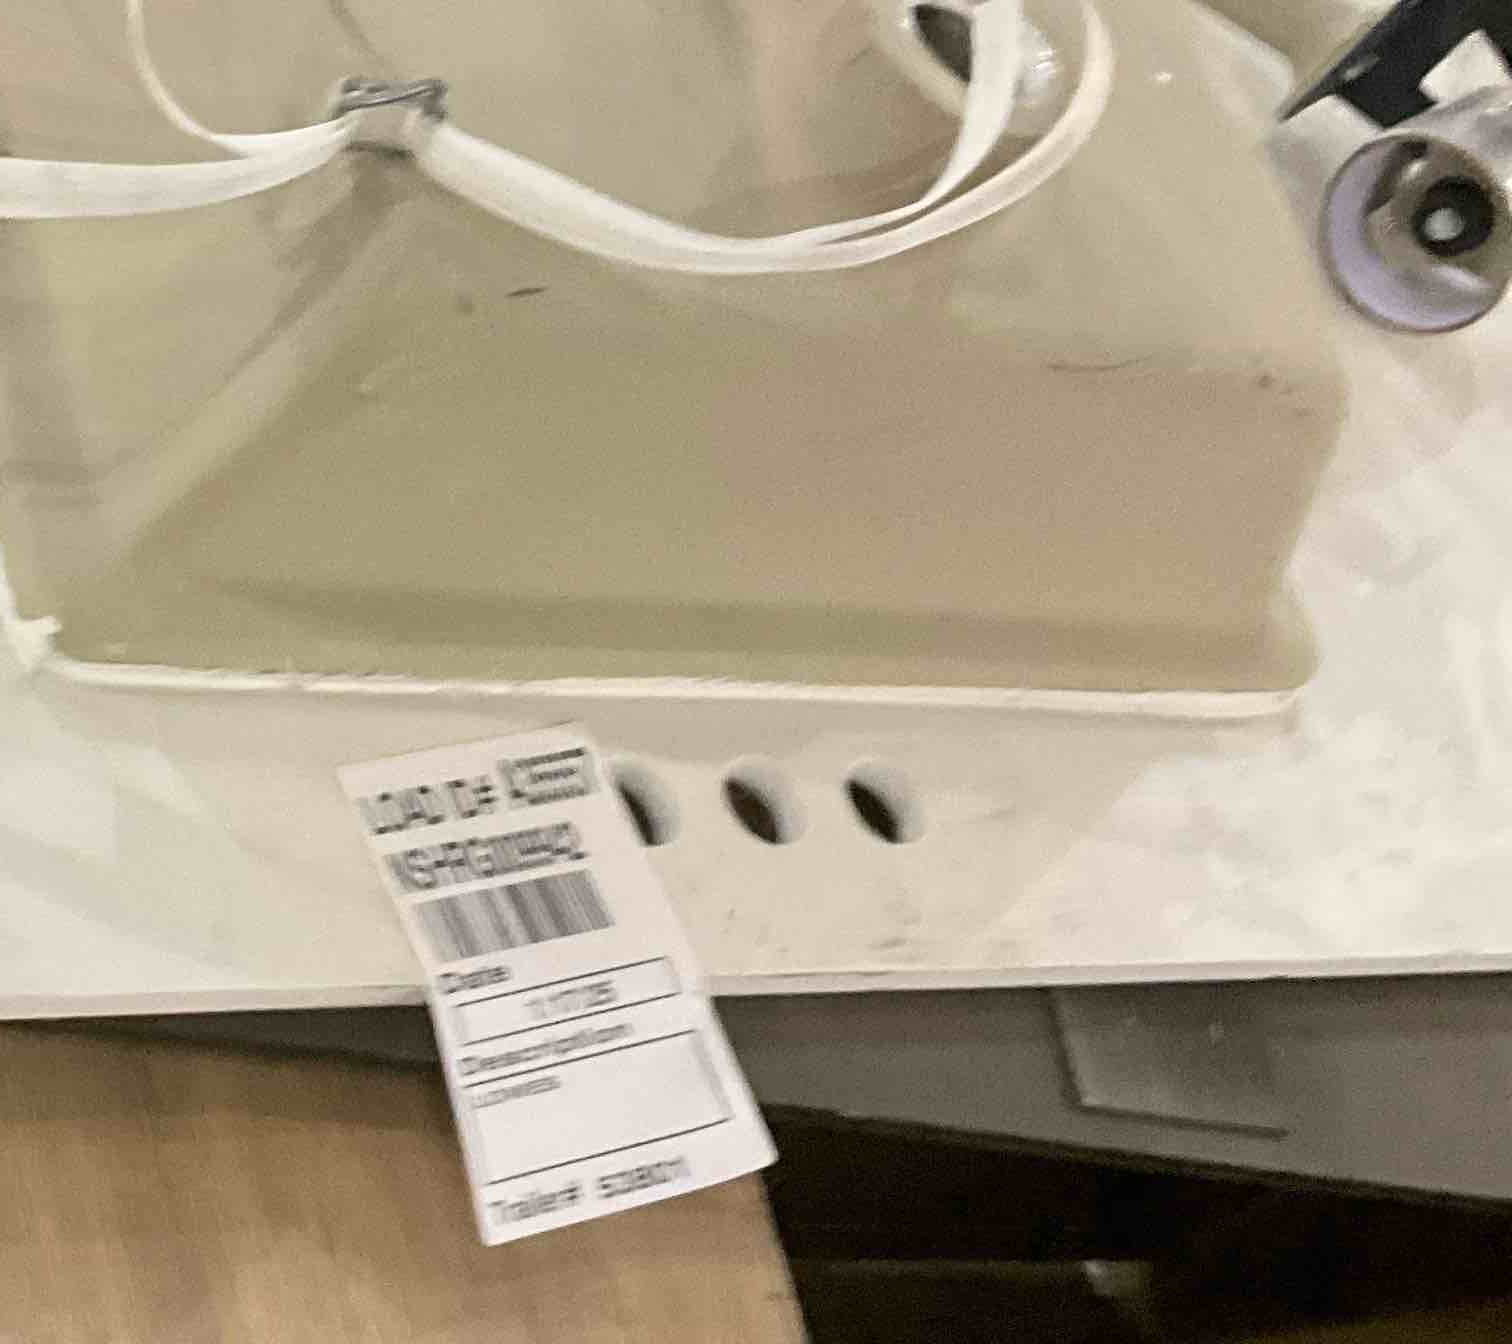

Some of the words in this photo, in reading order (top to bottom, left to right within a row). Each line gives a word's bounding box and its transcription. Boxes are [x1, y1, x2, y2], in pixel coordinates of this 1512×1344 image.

[354, 782, 454, 837] LOAD
[435, 963, 514, 996] Date
[457, 1021, 635, 1077] Description
